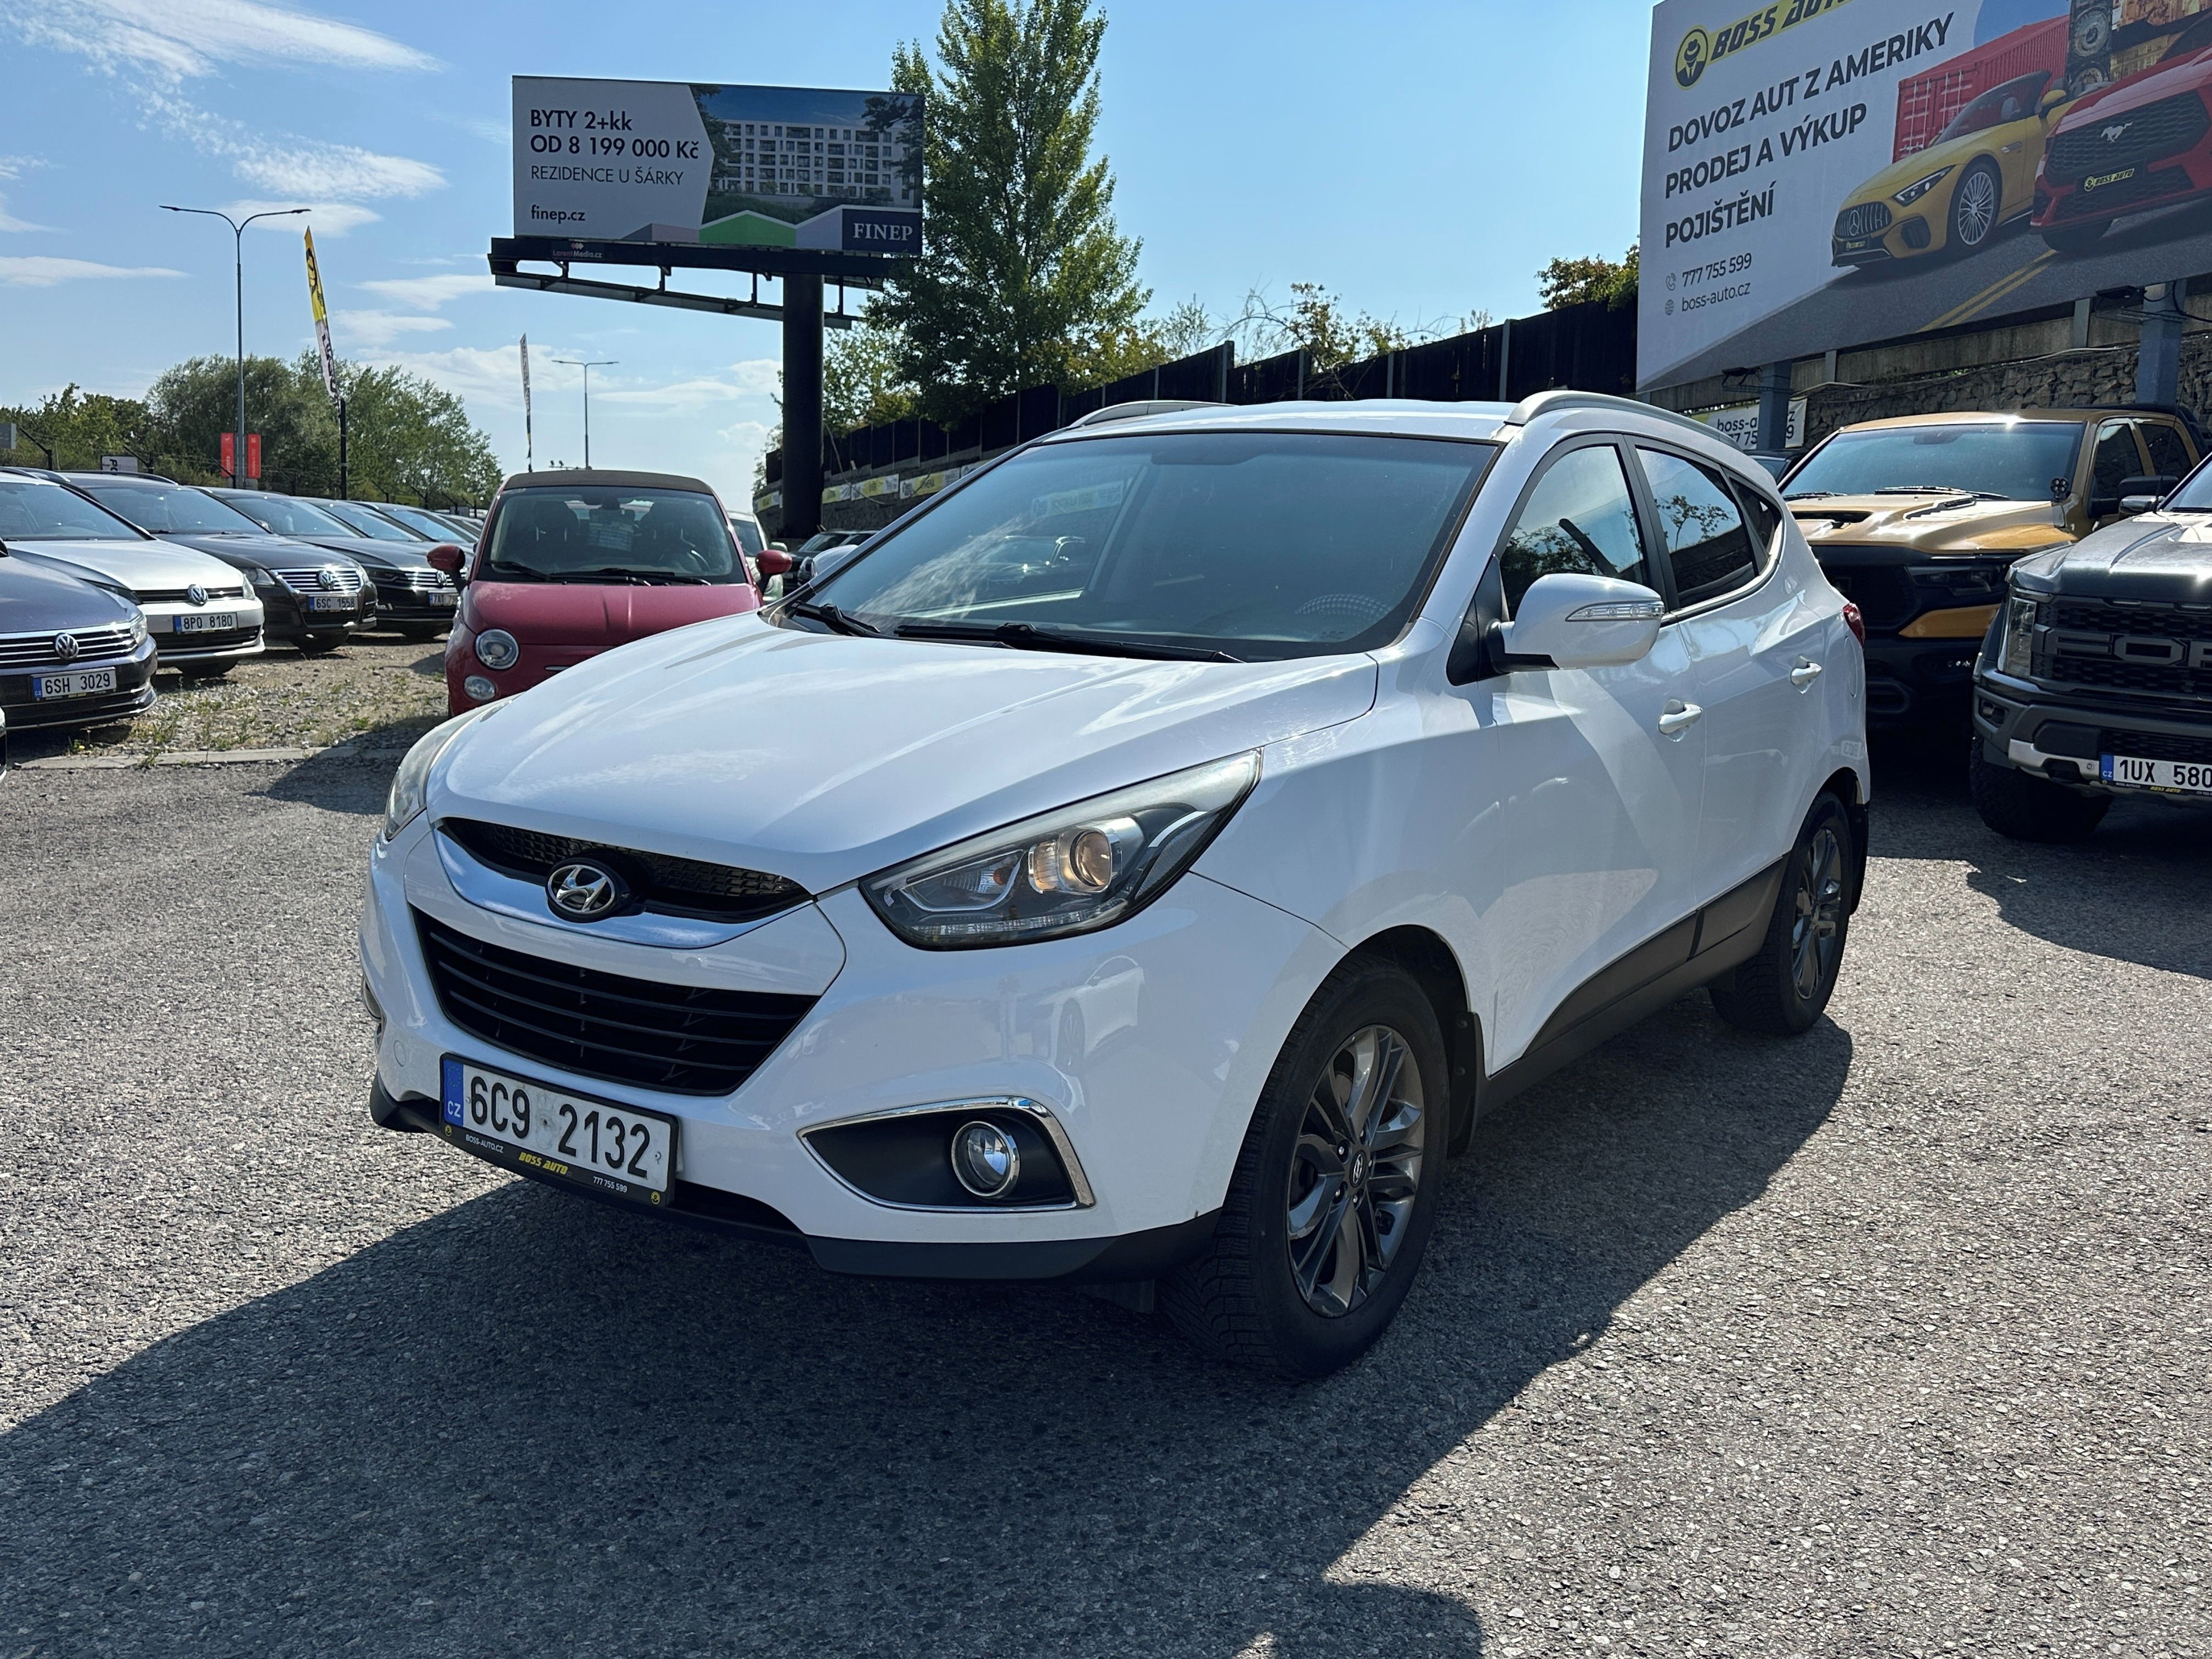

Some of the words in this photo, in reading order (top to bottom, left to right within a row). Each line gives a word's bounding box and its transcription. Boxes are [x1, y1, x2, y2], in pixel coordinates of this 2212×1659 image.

[1711, 5, 1779, 61] BOSS
[1668, 98, 1746, 153] DOVOZ
[1749, 76, 1799, 121] AUT
[1803, 67, 1821, 100] Z
[1825, 12, 1954, 92] AMERIKY
[531, 109, 578, 128] BYTY
[584, 111, 633, 131] 2+kk
[531, 134, 562, 153] OD
[568, 136, 580, 154] 8
[590, 137, 625, 156] 199
[632, 138, 670, 158] 000
[676, 140, 699, 159] Kč
[1666, 144, 1751, 199] PRODEJ
[1755, 138, 1774, 167] A
[1779, 103, 1867, 157] VÝKUP
[531, 166, 614, 183] REZIDENCE
[619, 169, 630, 183] U
[635, 166, 684, 185] ŠÁRKY
[531, 204, 586, 224] finep.cz
[1666, 180, 1777, 248] POJIŠTĚNÍ
[853, 223, 913, 241] FINEP
[1681, 267, 1703, 287] 777
[1706, 259, 1726, 280] 755
[1729, 252, 1752, 273] 599
[1681, 283, 1751, 312] boss-auto.cz
[316, 598, 332, 609] 6SC
[210, 614, 233, 628] 8180
[45, 678, 70, 695] 6SH
[80, 673, 111, 690] 3029
[2119, 759, 2155, 783] 1UX
[448, 1099, 461, 1119] CZ
[470, 1075, 531, 1140] 6C9
[558, 1103, 651, 1178] 2132
[465, 1133, 504, 1154] BOSS-AUTO.CZ
[518, 1152, 542, 1167] BOSS
[542, 1160, 568, 1176] AUTO
[592, 1176, 604, 1187] 777
[604, 1179, 615, 1190] 755
[615, 1183, 628, 1193] 599
